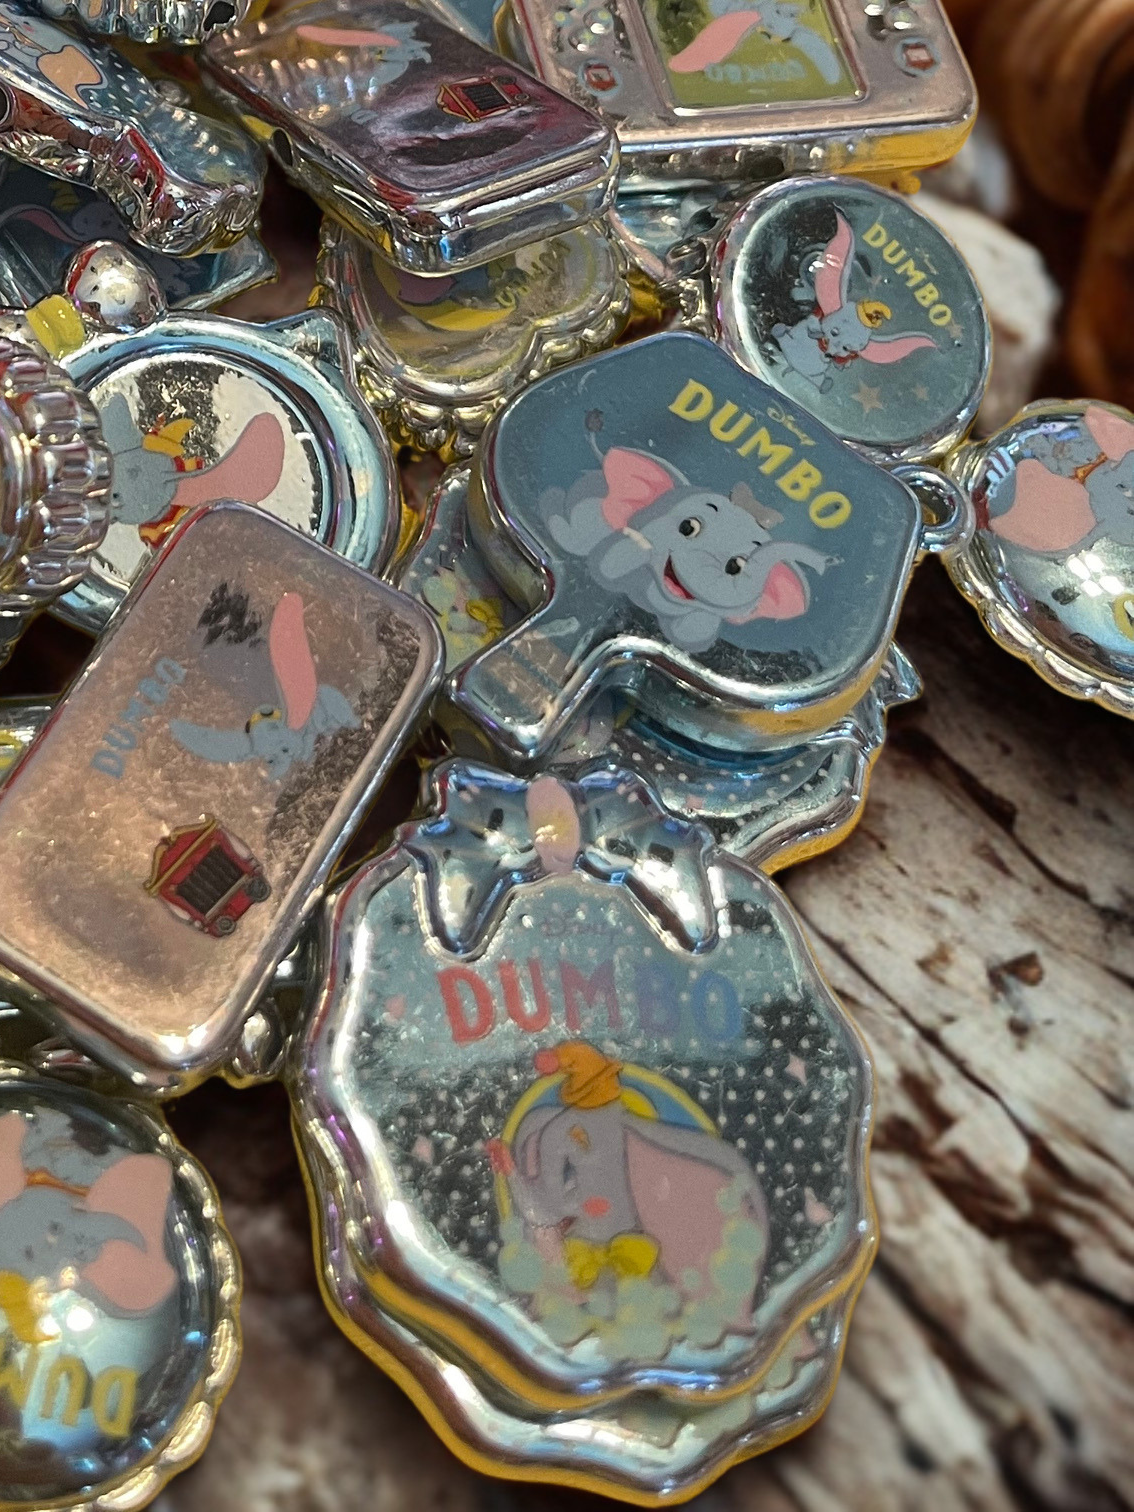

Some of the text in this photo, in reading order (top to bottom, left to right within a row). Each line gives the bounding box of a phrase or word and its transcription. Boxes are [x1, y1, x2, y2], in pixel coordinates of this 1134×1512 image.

[862, 222, 952, 327] DUMBO
[668, 378, 852, 529] DUMBO
[90, 657, 187, 780] DUMBO
[436, 955, 743, 1049] DUMBO
